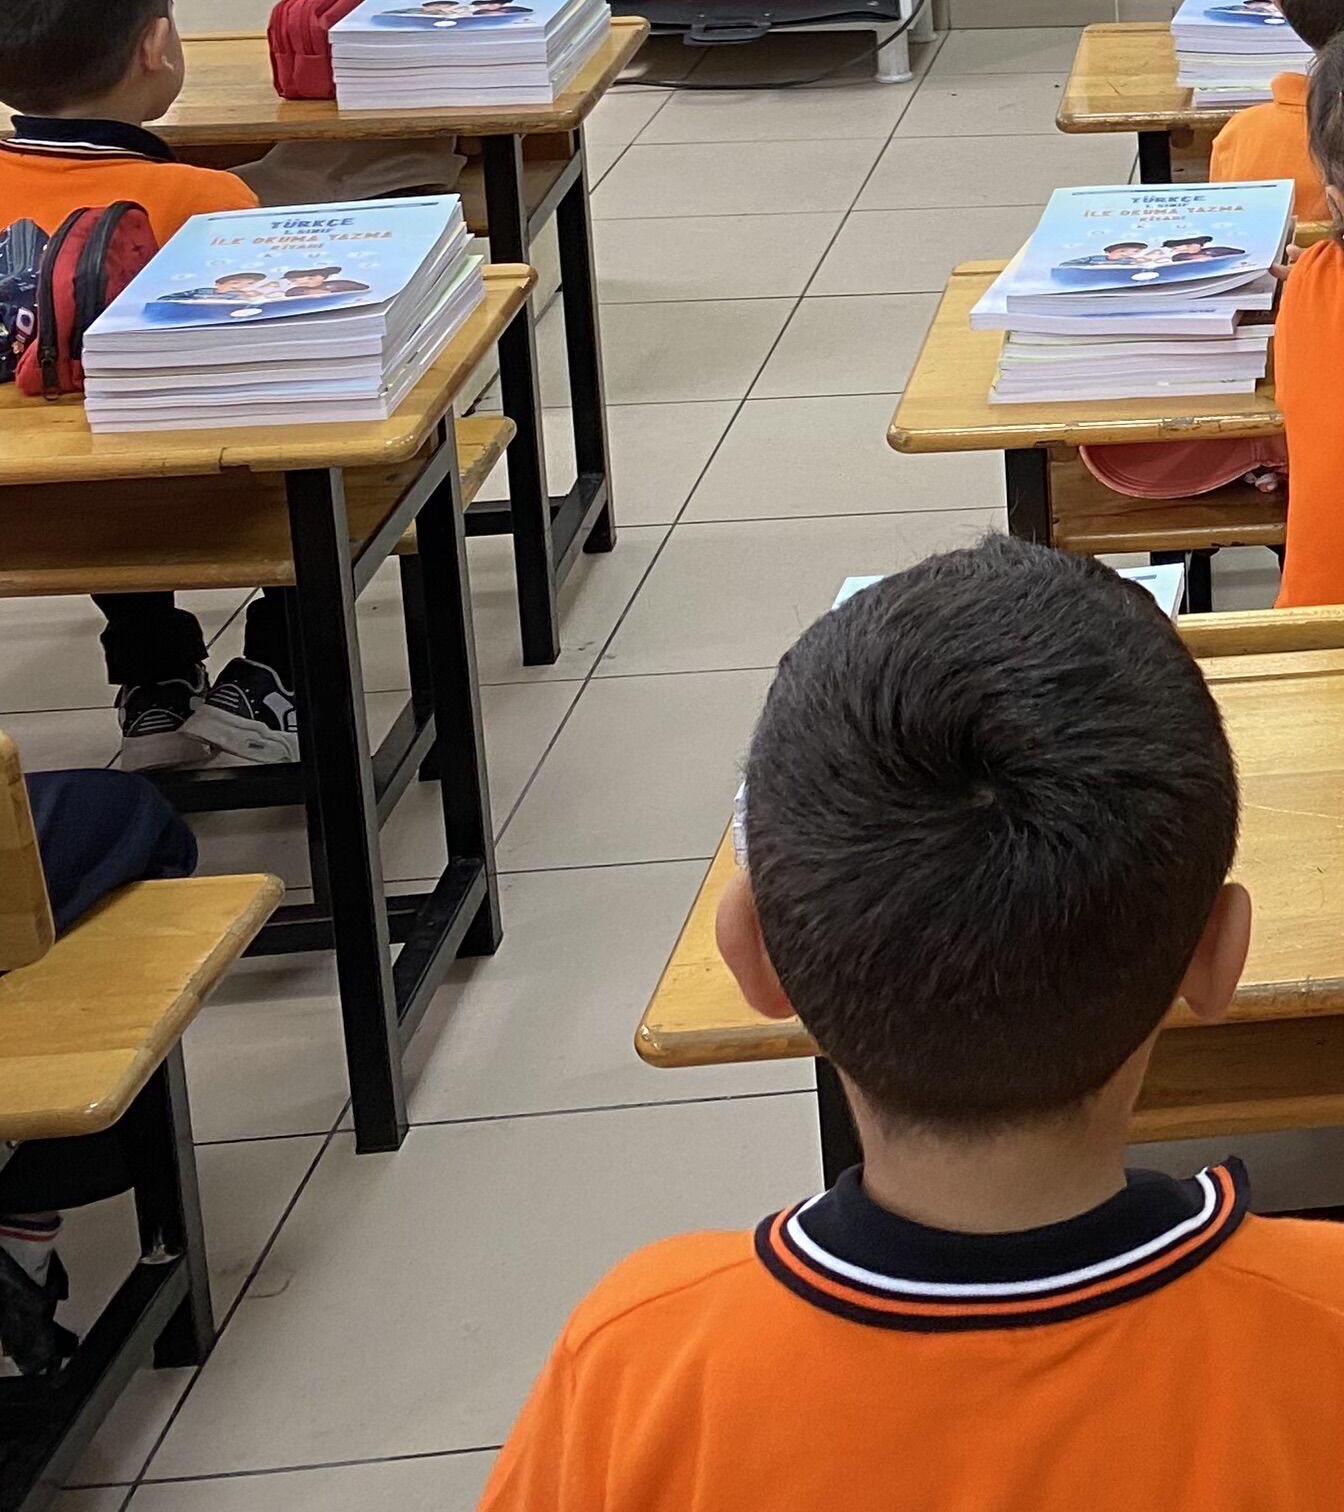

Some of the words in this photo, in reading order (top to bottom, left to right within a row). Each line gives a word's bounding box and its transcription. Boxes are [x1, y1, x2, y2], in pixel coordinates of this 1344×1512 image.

[1131, 195, 1207, 204] TÜRKÇE
[1083, 209, 1112, 217] İLK
[1120, 208, 1178, 216] OKUMA
[1187, 205, 1245, 214] YAZMA
[270, 217, 356, 229] TÜRKÇE
[253, 235, 319, 244] OKUMA
[329, 231, 393, 241] YAZMA
